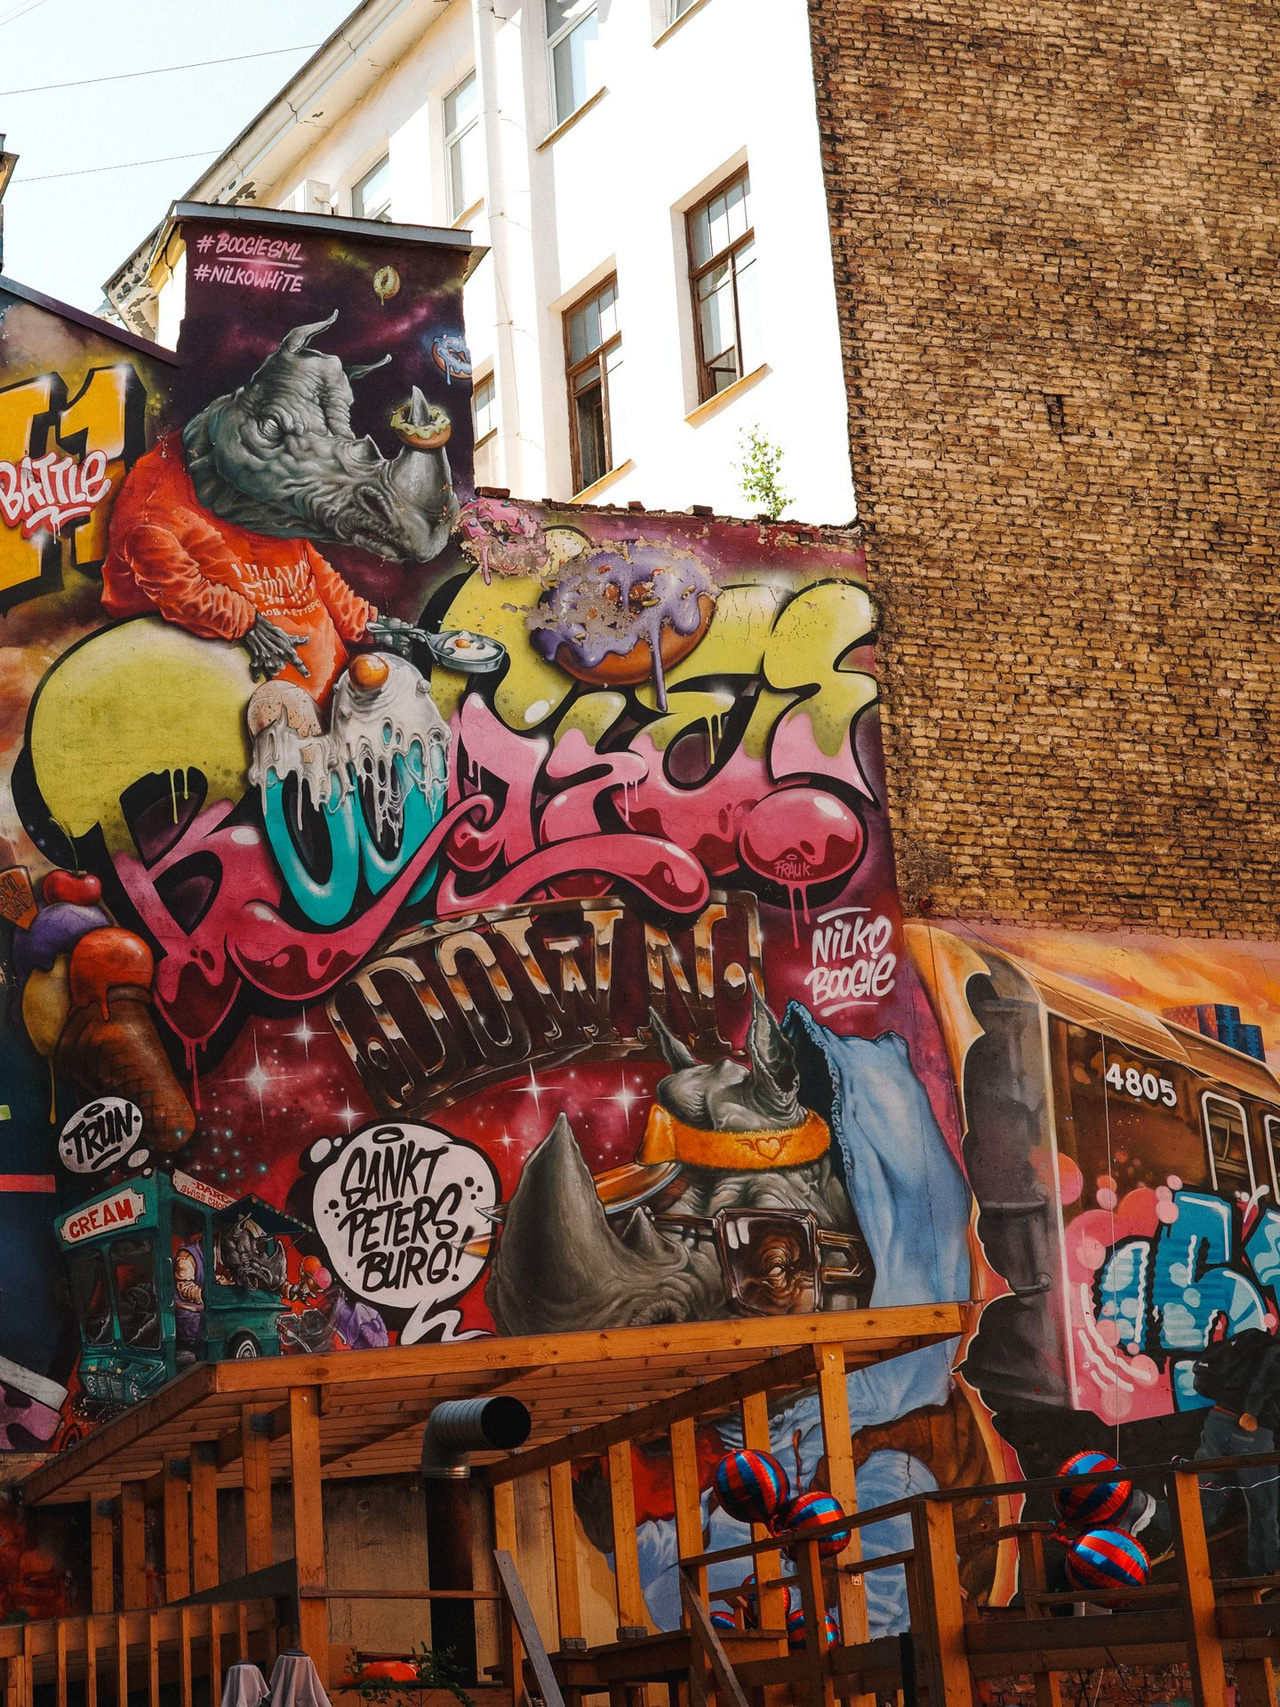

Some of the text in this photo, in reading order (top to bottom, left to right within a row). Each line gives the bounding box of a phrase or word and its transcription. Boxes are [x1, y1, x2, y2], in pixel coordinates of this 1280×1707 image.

[1106, 1063, 1177, 1107] 4805
[64, 1103, 132, 1164] TRUN
[180, 1184, 206, 1202] SWISS
[340, 1140, 449, 1211] SANKT
[68, 1198, 134, 1239] CREAM
[338, 1182, 462, 1257] PETERS
[357, 1225, 474, 1292] BURG!
